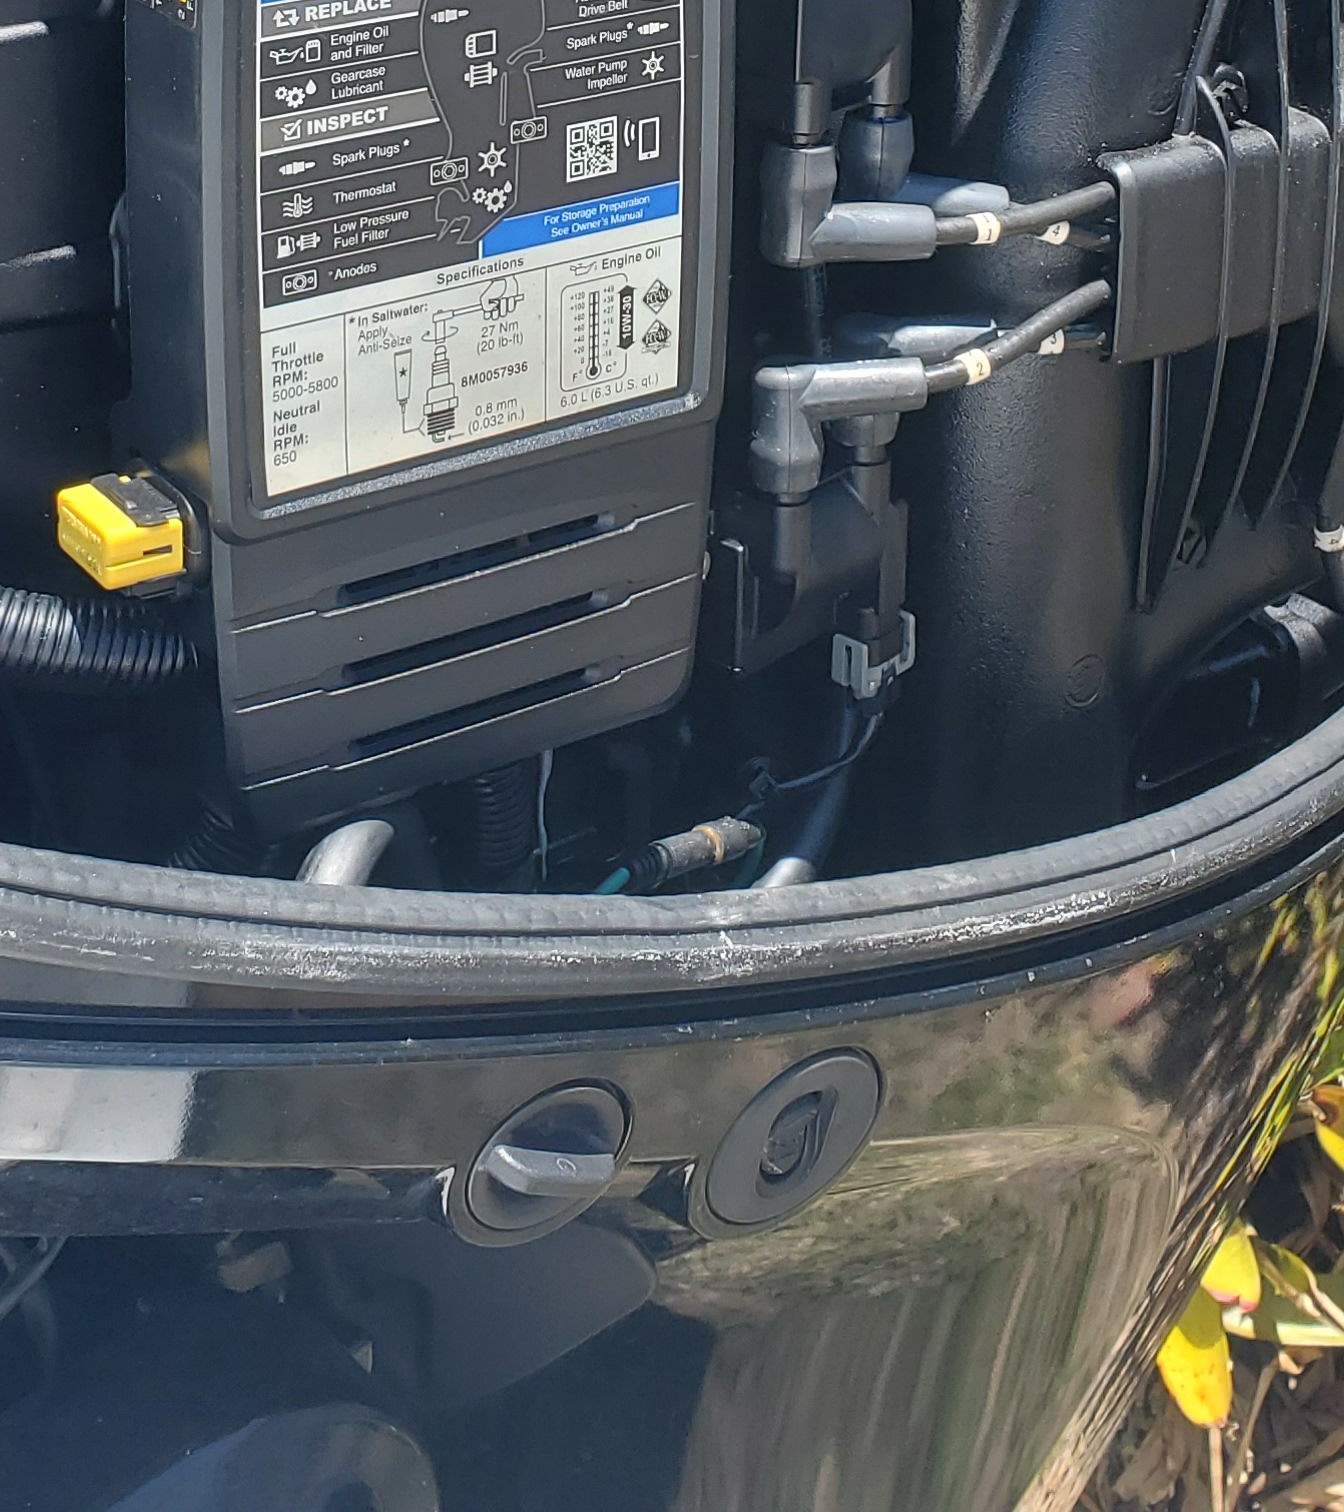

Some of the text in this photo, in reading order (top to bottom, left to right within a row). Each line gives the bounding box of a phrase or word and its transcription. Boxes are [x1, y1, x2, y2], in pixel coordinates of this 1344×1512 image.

[578, 3, 606, 18] Drive
[330, 24, 389, 48] Engine Oil
[566, 35, 597, 50] Spark
[330, 42, 384, 62] and Filter
[330, 65, 386, 86] Gearcase
[565, 59, 628, 80] Water Pump
[587, 72, 628, 90] Impeller
[330, 79, 384, 100] Lubricant
[307, 105, 389, 135] INSPECT
[332, 148, 366, 168] Spark
[333, 180, 397, 205] Thermostat
[543, 193, 651, 226] For Storage Preparation
[333, 209, 409, 235] Low Pressure
[551, 208, 644, 239] See Owner's Manual
[333, 227, 389, 249] Fuel Filter
[601, 245, 662, 272] Engine Oil
[436, 255, 525, 286] Specifications
[371, 301, 429, 325] Saltwater:
[621, 295, 632, 339] 10W-30
[358, 326, 388, 344] Apply
[481, 319, 519, 339] 27 Nm
[272, 341, 296, 359] Full
[358, 333, 413, 356] Anti-Seize
[476, 330, 524, 356] (20 lb-ft)
[272, 350, 324, 373] Throttle
[272, 370, 308, 388] RPM:
[460, 361, 529, 389] 8M0057936
[272, 375, 339, 403] 5000-5800
[560, 395, 579, 409] 6.0
[581, 391, 588, 403] L
[591, 384, 612, 403] (6.3
[273, 399, 321, 424] Neutral
[475, 397, 518, 418] 0.8 mm
[273, 421, 297, 438] Idle
[468, 407, 525, 436] (0.032 in.)
[273, 433, 309, 452] RPM:
[273, 450, 297, 467] 650
